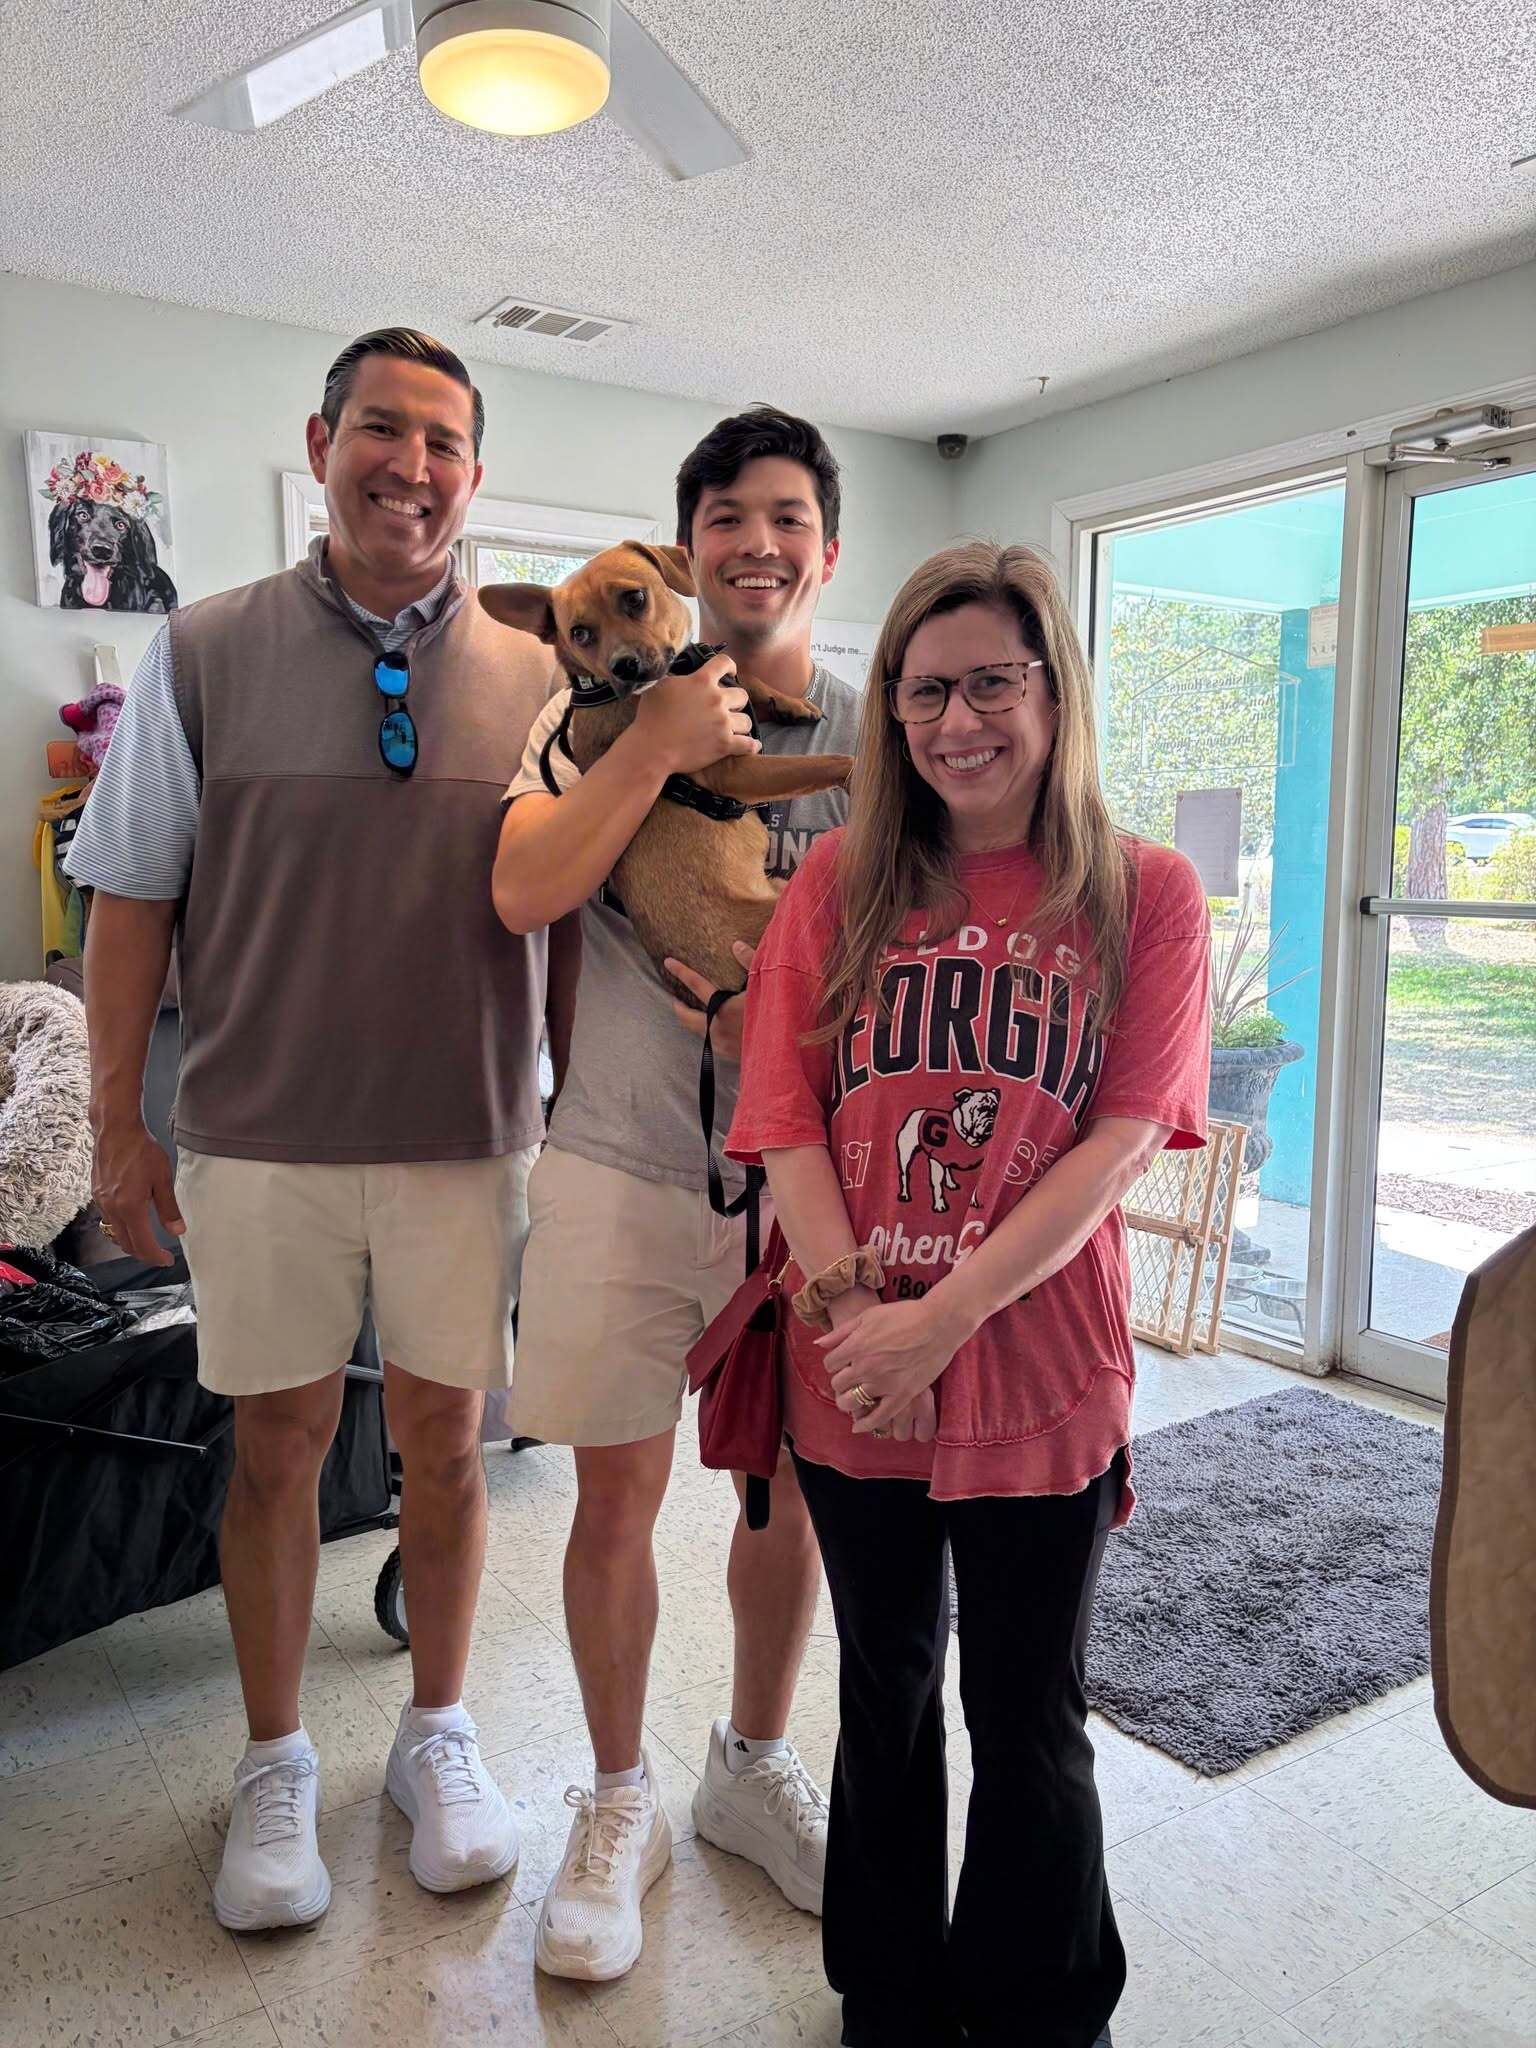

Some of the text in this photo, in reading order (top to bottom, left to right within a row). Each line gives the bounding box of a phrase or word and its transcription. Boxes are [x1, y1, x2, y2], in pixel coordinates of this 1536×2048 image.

[823, 644, 846, 655] Judge
[923, 1115, 949, 1148] G
[841, 1140, 872, 1189] 17
